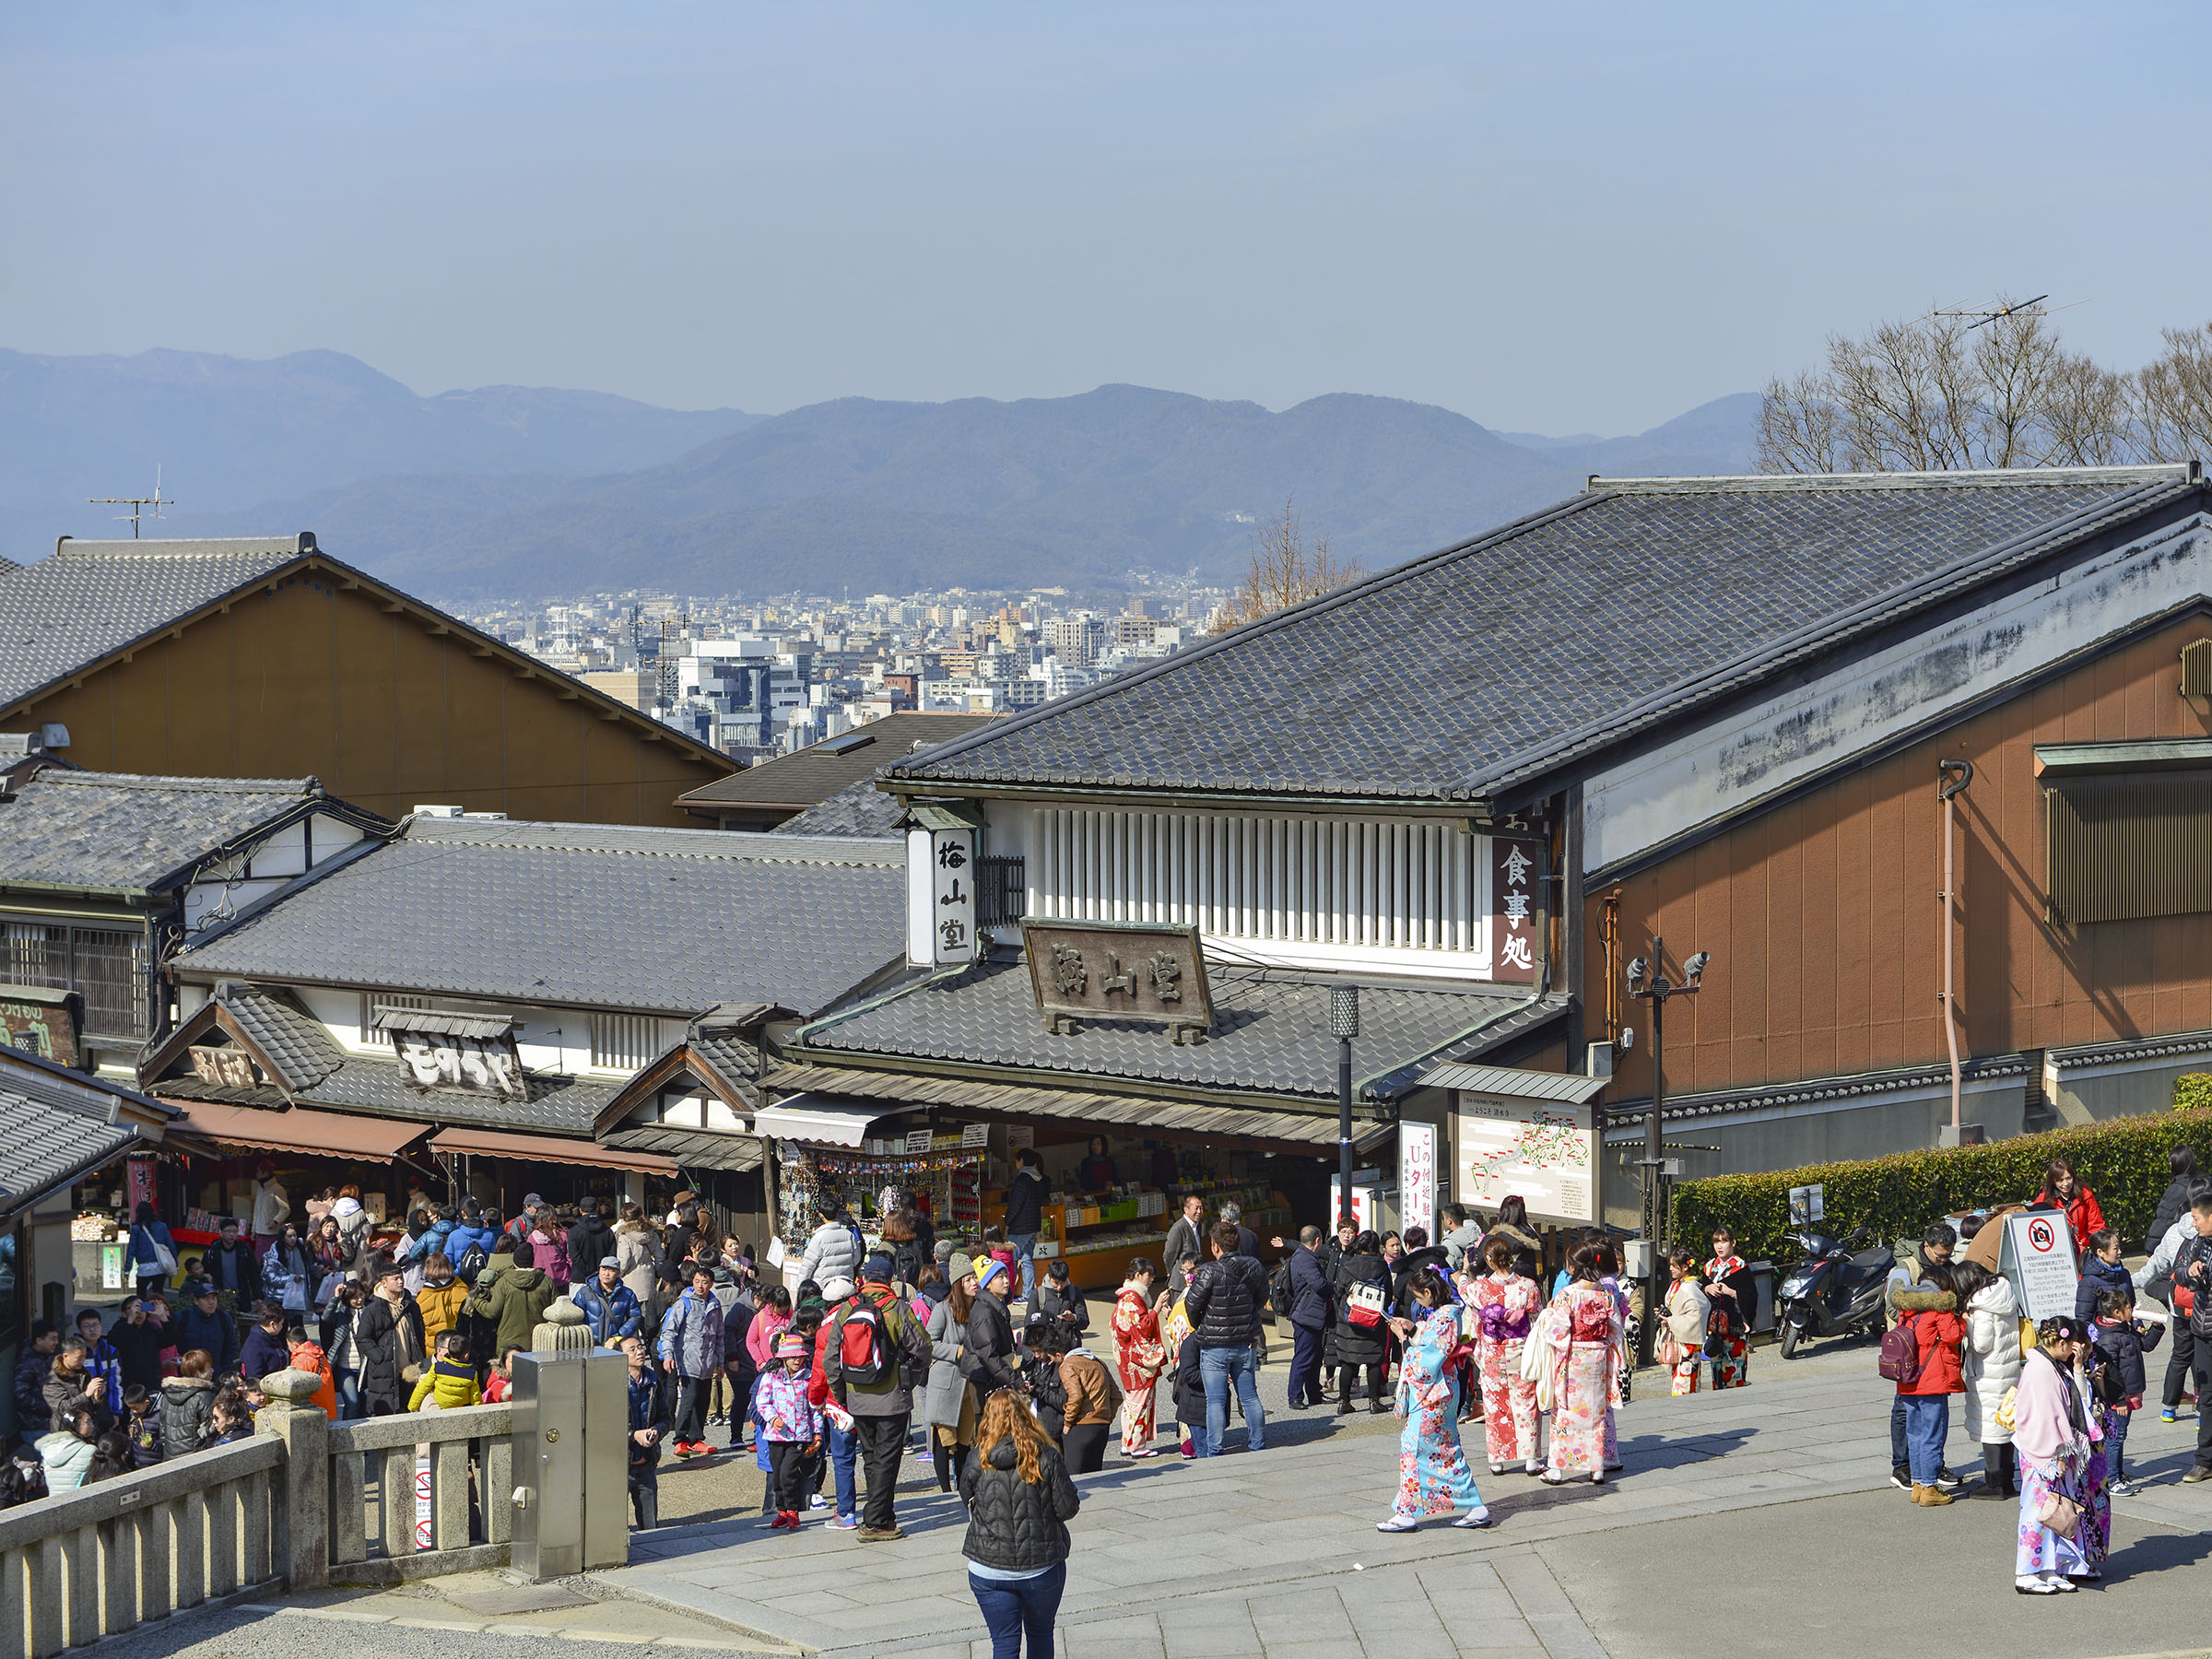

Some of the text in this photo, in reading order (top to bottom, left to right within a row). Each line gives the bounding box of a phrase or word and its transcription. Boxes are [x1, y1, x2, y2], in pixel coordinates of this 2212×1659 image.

[938, 841, 968, 952] 梅山堂
[1049, 943, 1182, 1002] 梅山堂
[1475, 1105, 1510, 1118] ようこそ 清水寺
